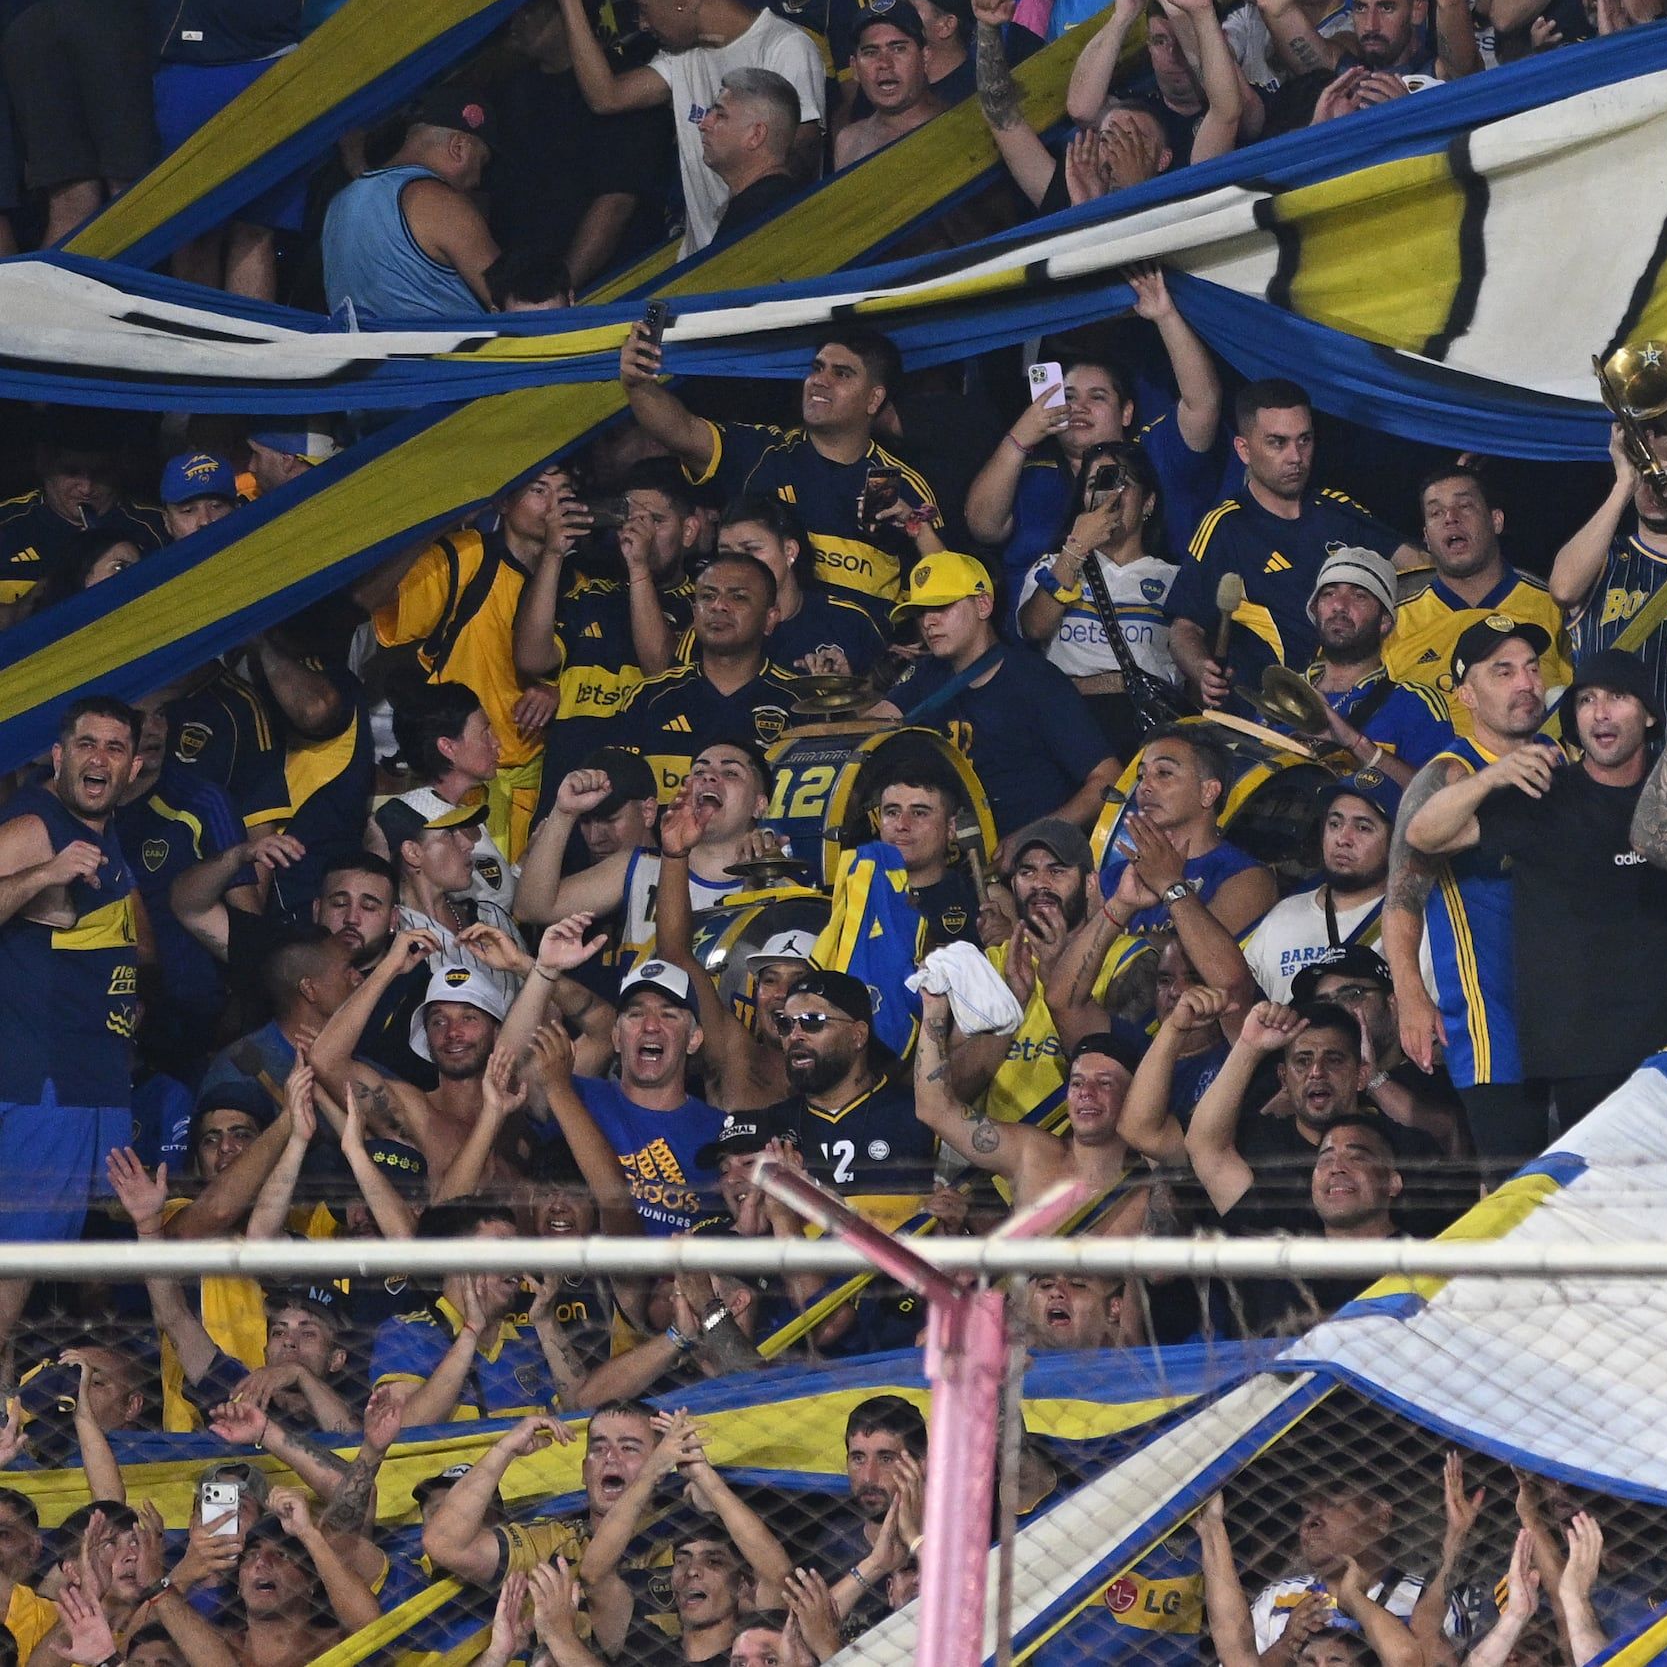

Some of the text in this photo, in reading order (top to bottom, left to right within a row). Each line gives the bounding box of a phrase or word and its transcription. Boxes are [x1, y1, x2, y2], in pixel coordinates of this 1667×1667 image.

[1059, 623, 1153, 649] betson
[769, 766, 837, 820] 12
[638, 1205, 692, 1229] JUNIORS
[1145, 1589, 1182, 1615] LG
